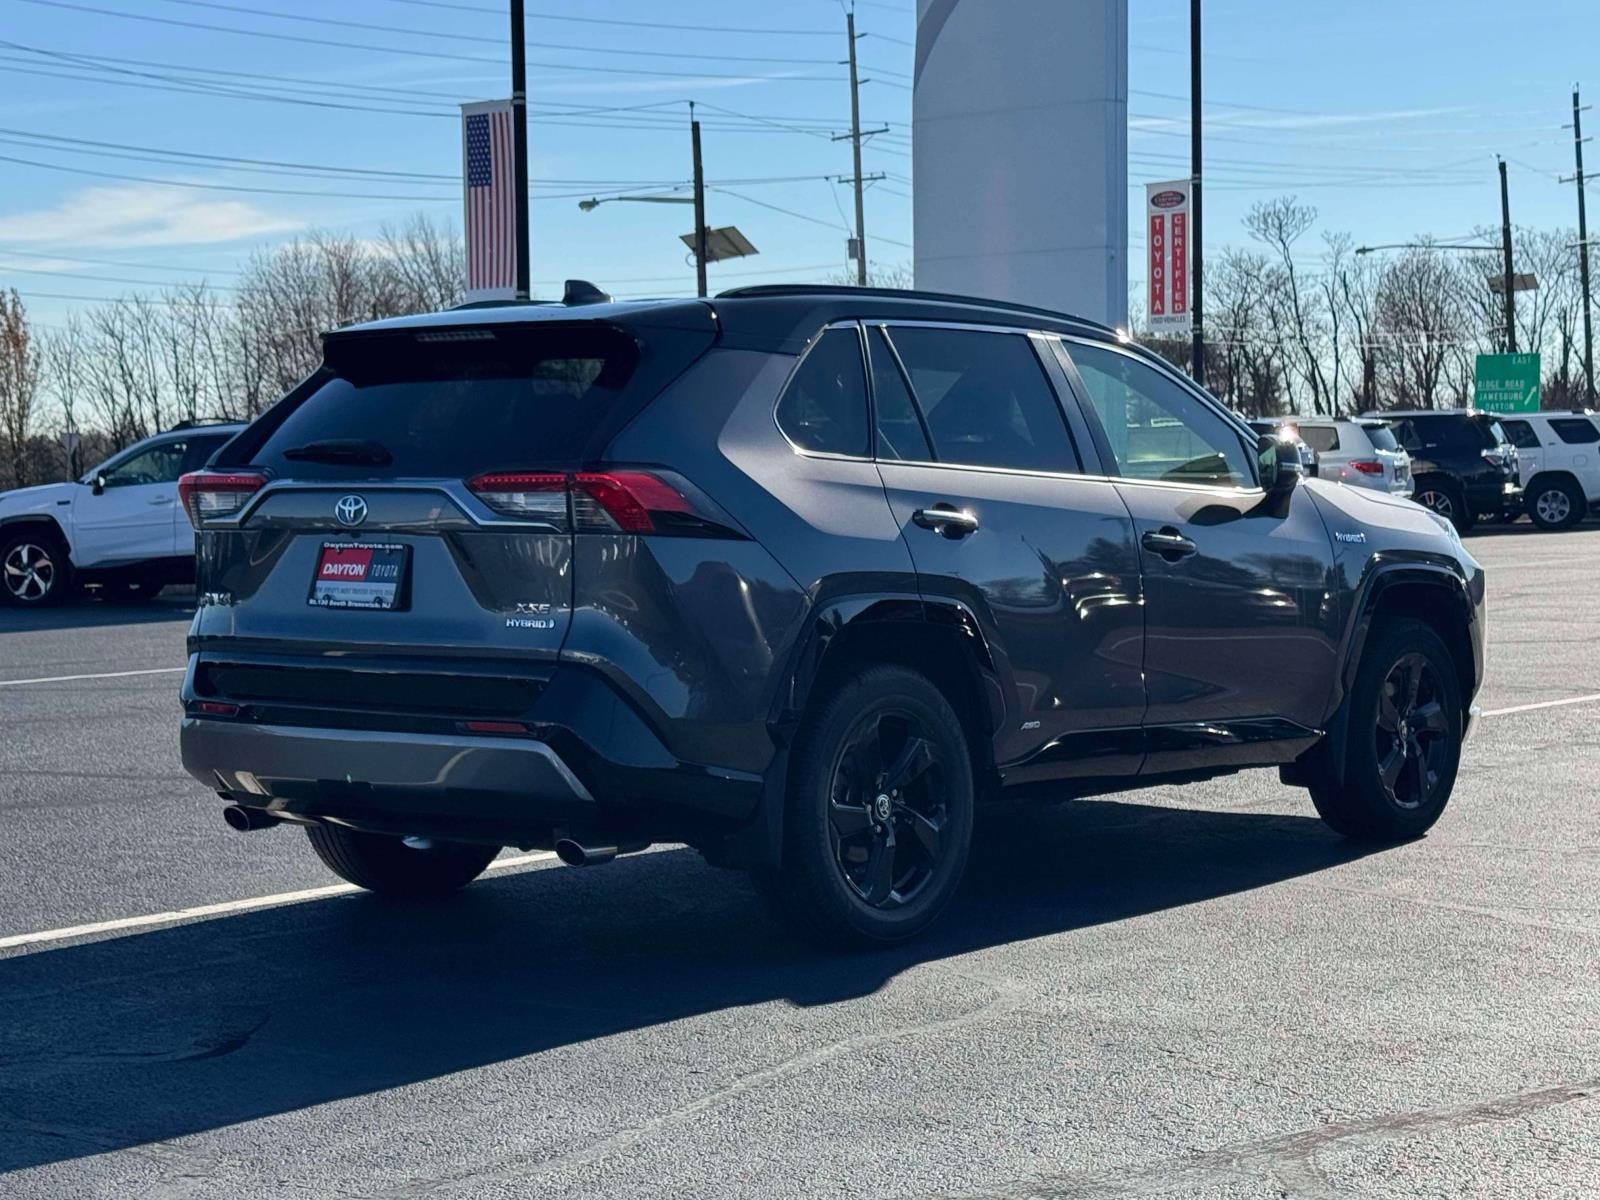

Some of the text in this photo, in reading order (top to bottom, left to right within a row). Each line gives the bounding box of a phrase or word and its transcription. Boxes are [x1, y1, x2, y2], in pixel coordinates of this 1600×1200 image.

[1153, 218, 1162, 311] TOYOTA
[1174, 215, 1183, 312] CERTIFIED
[1512, 356, 1532, 364] EAST
[1479, 392, 1524, 402] JAMESBURG
[1486, 402, 1515, 411] DAYTON
[323, 542, 403, 550] DaytonToyota.com
[322, 563, 399, 577] DAYTON TOYOTA
[515, 603, 551, 614] XSE
[506, 619, 547, 629] HYBRID
